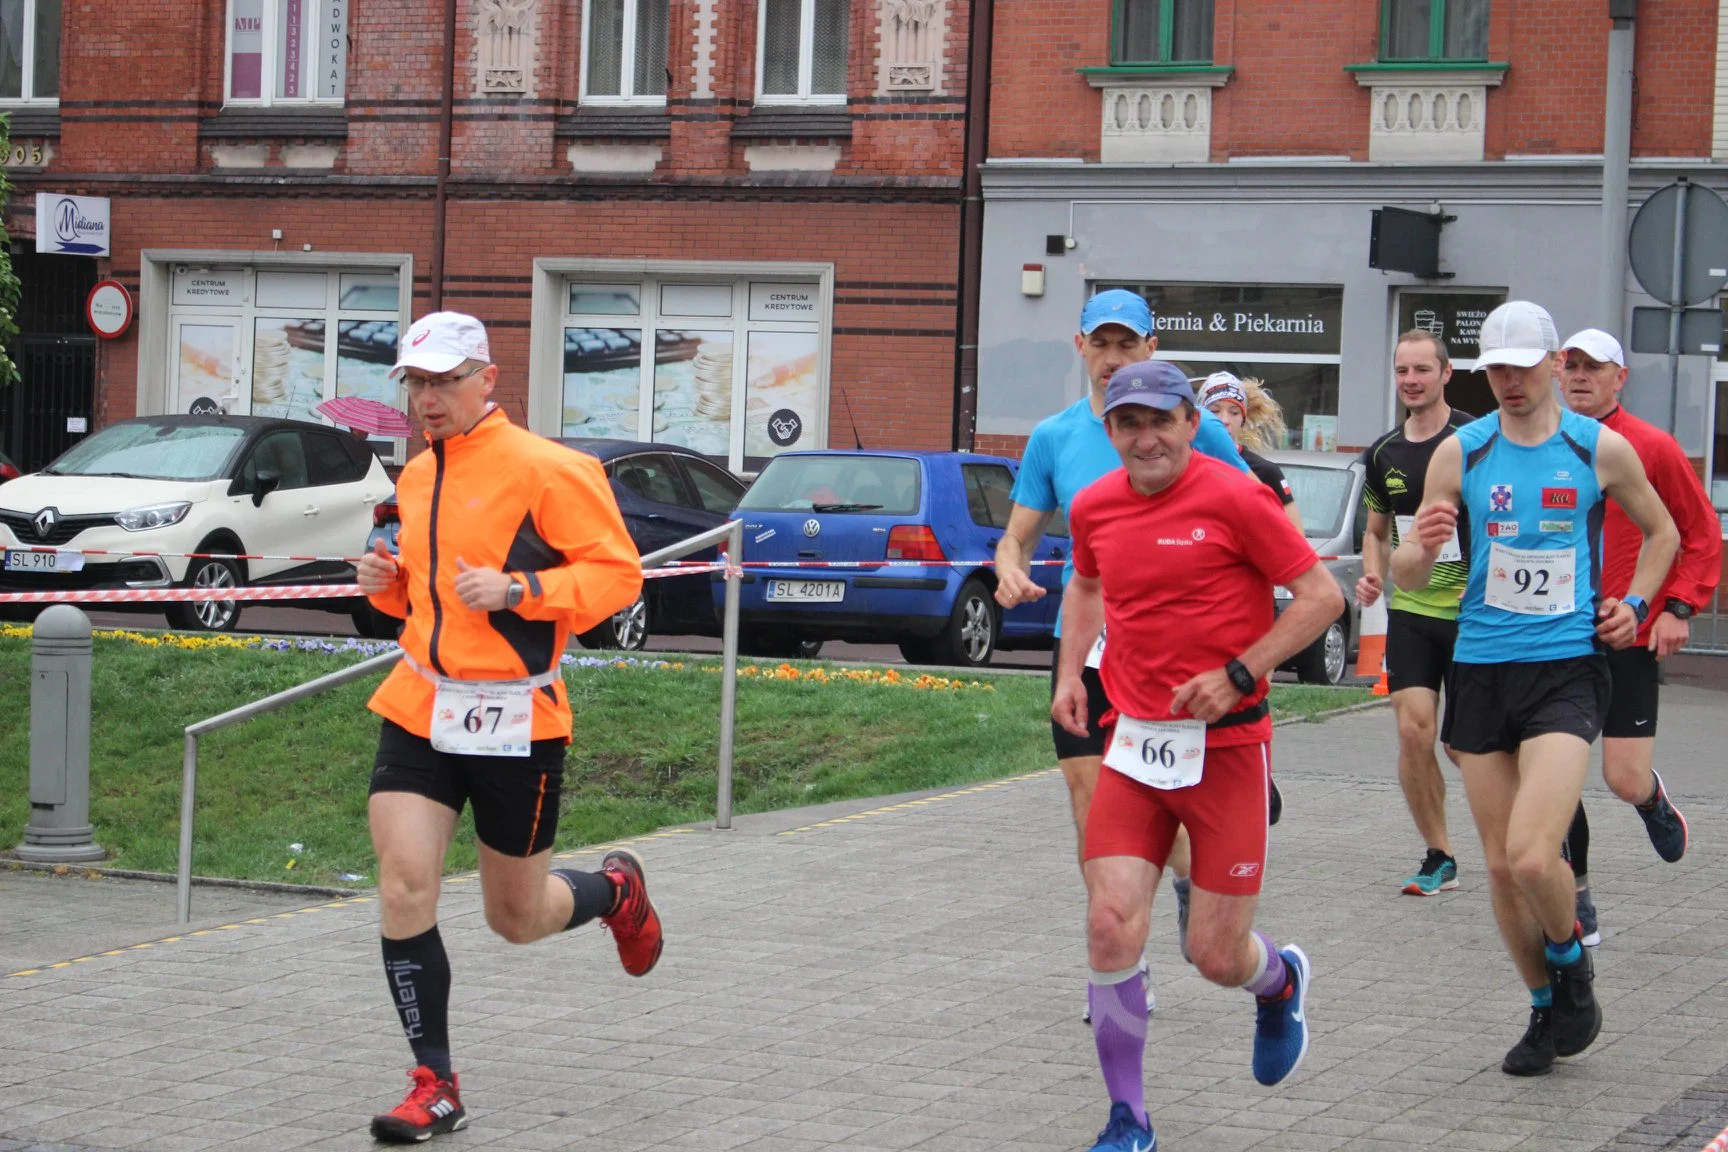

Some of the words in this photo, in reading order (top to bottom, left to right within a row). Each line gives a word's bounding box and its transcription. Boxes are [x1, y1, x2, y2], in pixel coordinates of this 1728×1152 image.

[58, 204, 104, 238] Midiana
[186, 288, 230, 296] KREDYTOWE
[764, 303, 814, 311] KREDYTOWE
[1151, 311, 1203, 331] iernia
[1209, 312, 1227, 332] &
[1233, 313, 1324, 334] Piekarnia
[1450, 337, 1462, 345] NA
[1462, 337, 1480, 345] WYN
[13, 553, 29, 567] SL
[33, 554, 56, 568] 910
[776, 582, 794, 597] SL
[800, 583, 840, 597] 4201A
[1513, 568, 1550, 596] 92
[464, 706, 504, 735] 67
[1142, 737, 1176, 769] 66
[387, 960, 423, 1039] kalenji
